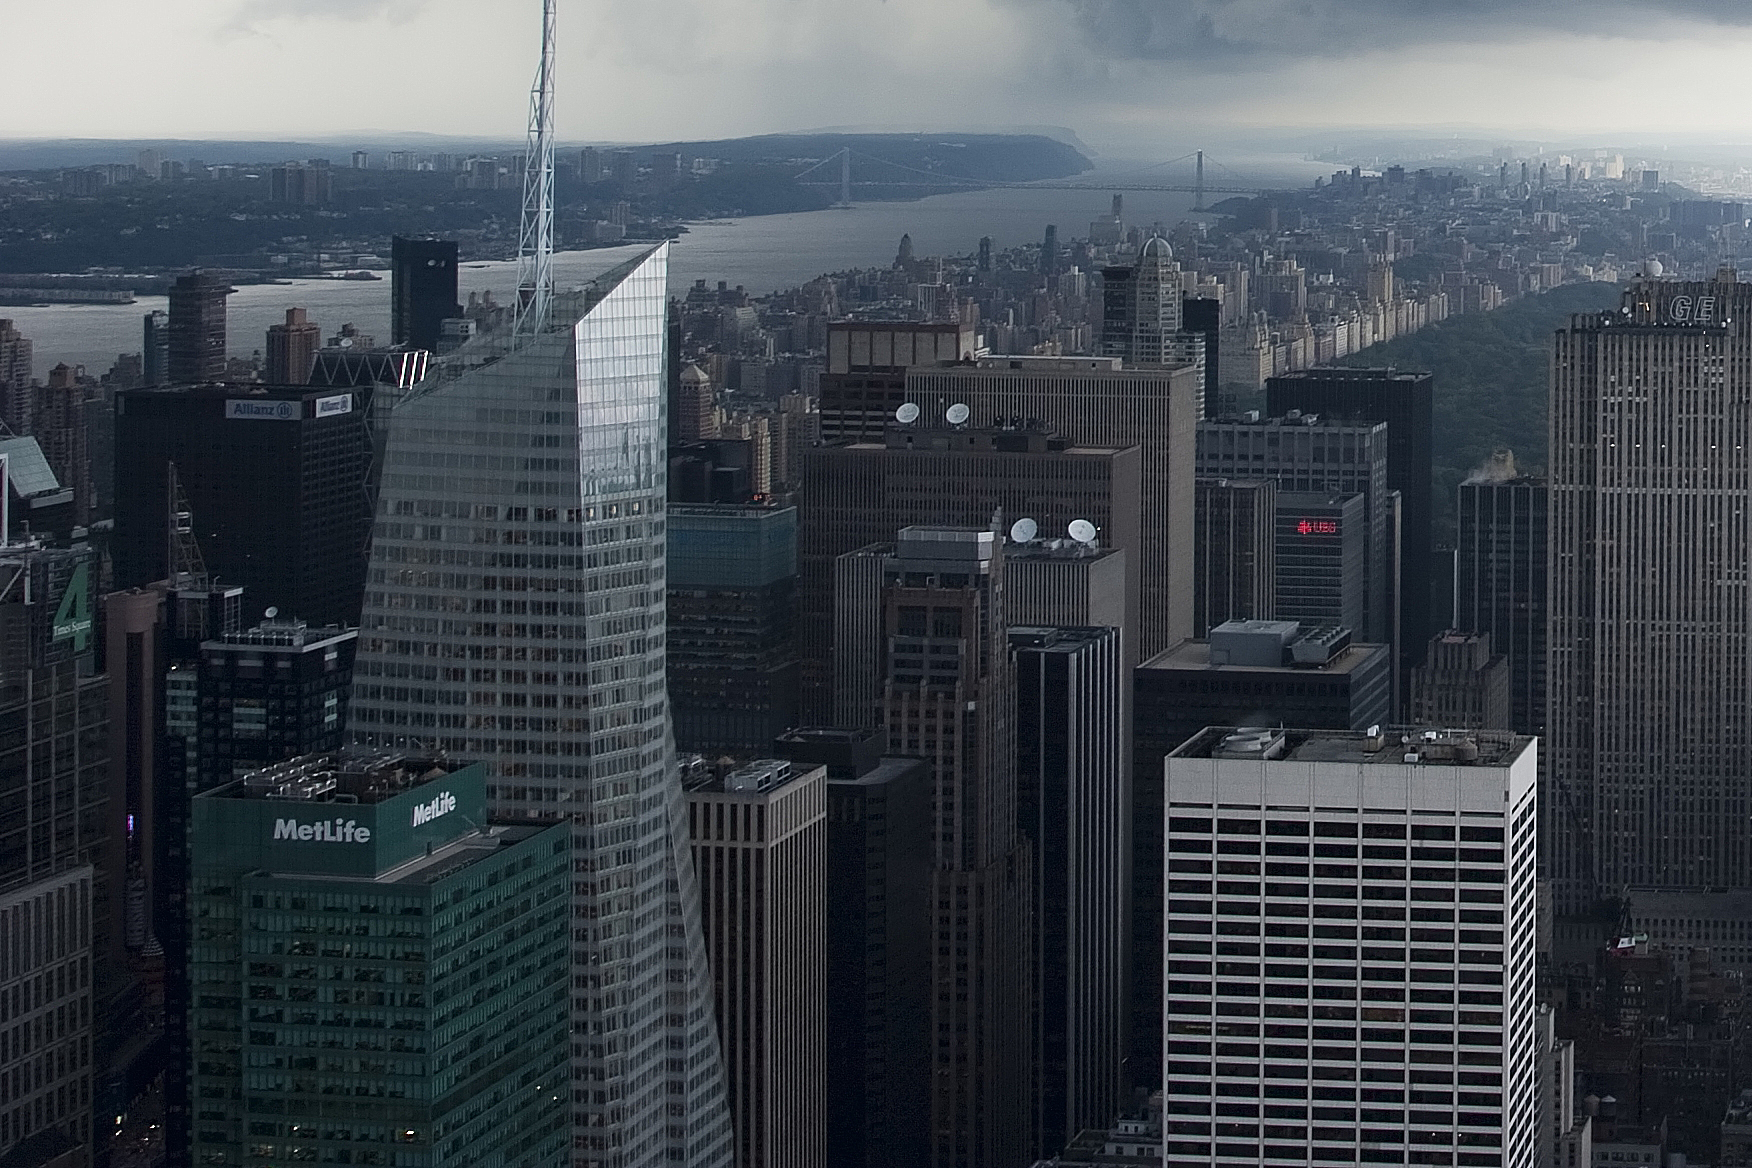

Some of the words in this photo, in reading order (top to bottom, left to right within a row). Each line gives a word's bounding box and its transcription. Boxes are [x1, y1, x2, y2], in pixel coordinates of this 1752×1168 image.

[1670, 295, 1715, 320] GE
[234, 403, 274, 415] Allianz
[53, 561, 91, 651] 4
[413, 791, 456, 827] MetLife
[273, 817, 371, 843] MetLife
